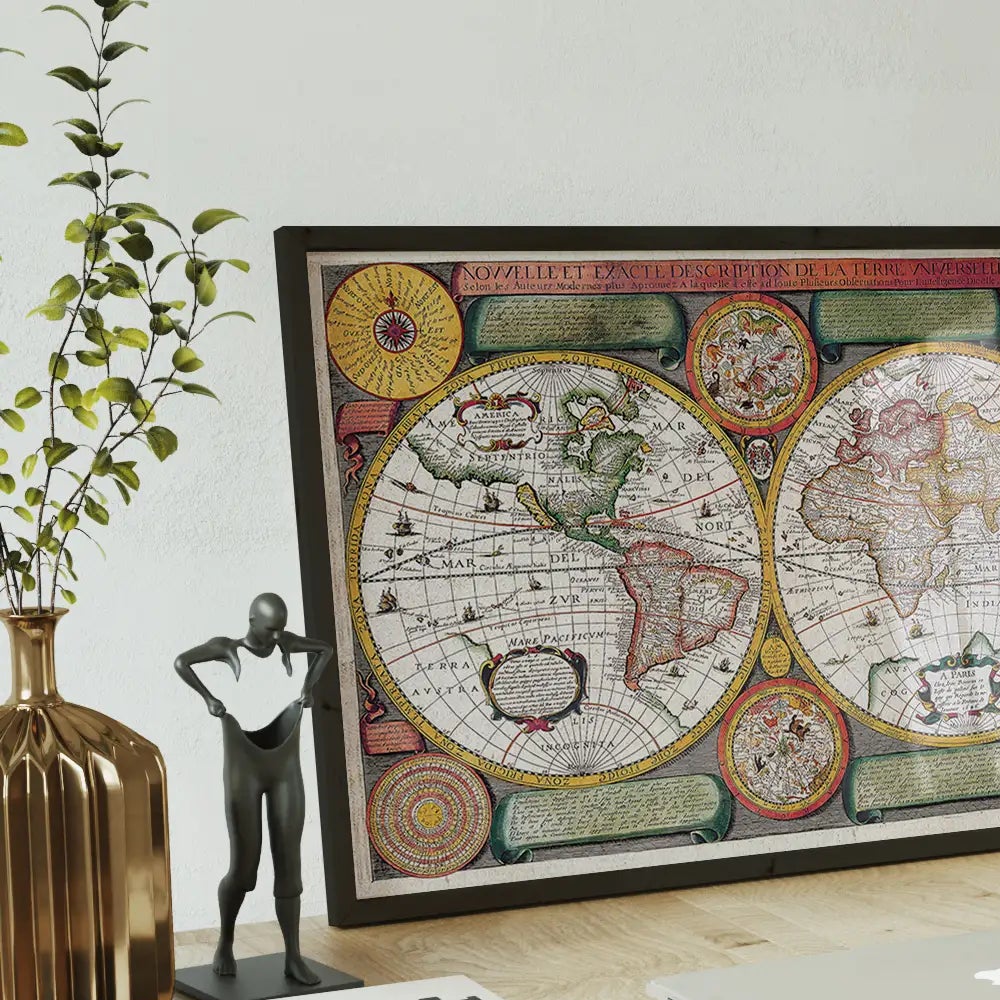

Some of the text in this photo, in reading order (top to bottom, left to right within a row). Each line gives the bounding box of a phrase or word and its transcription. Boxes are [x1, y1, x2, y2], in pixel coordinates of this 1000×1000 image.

[563, 265, 585, 279] ET
[594, 264, 665, 279] EXACTE
[671, 263, 790, 278] DESCRIPTION
[796, 263, 817, 277] DE
[824, 262, 847, 276] LA
[851, 262, 905, 276] TERRE
[442, 558, 477, 569] MAR
[551, 554, 579, 564] DEL
